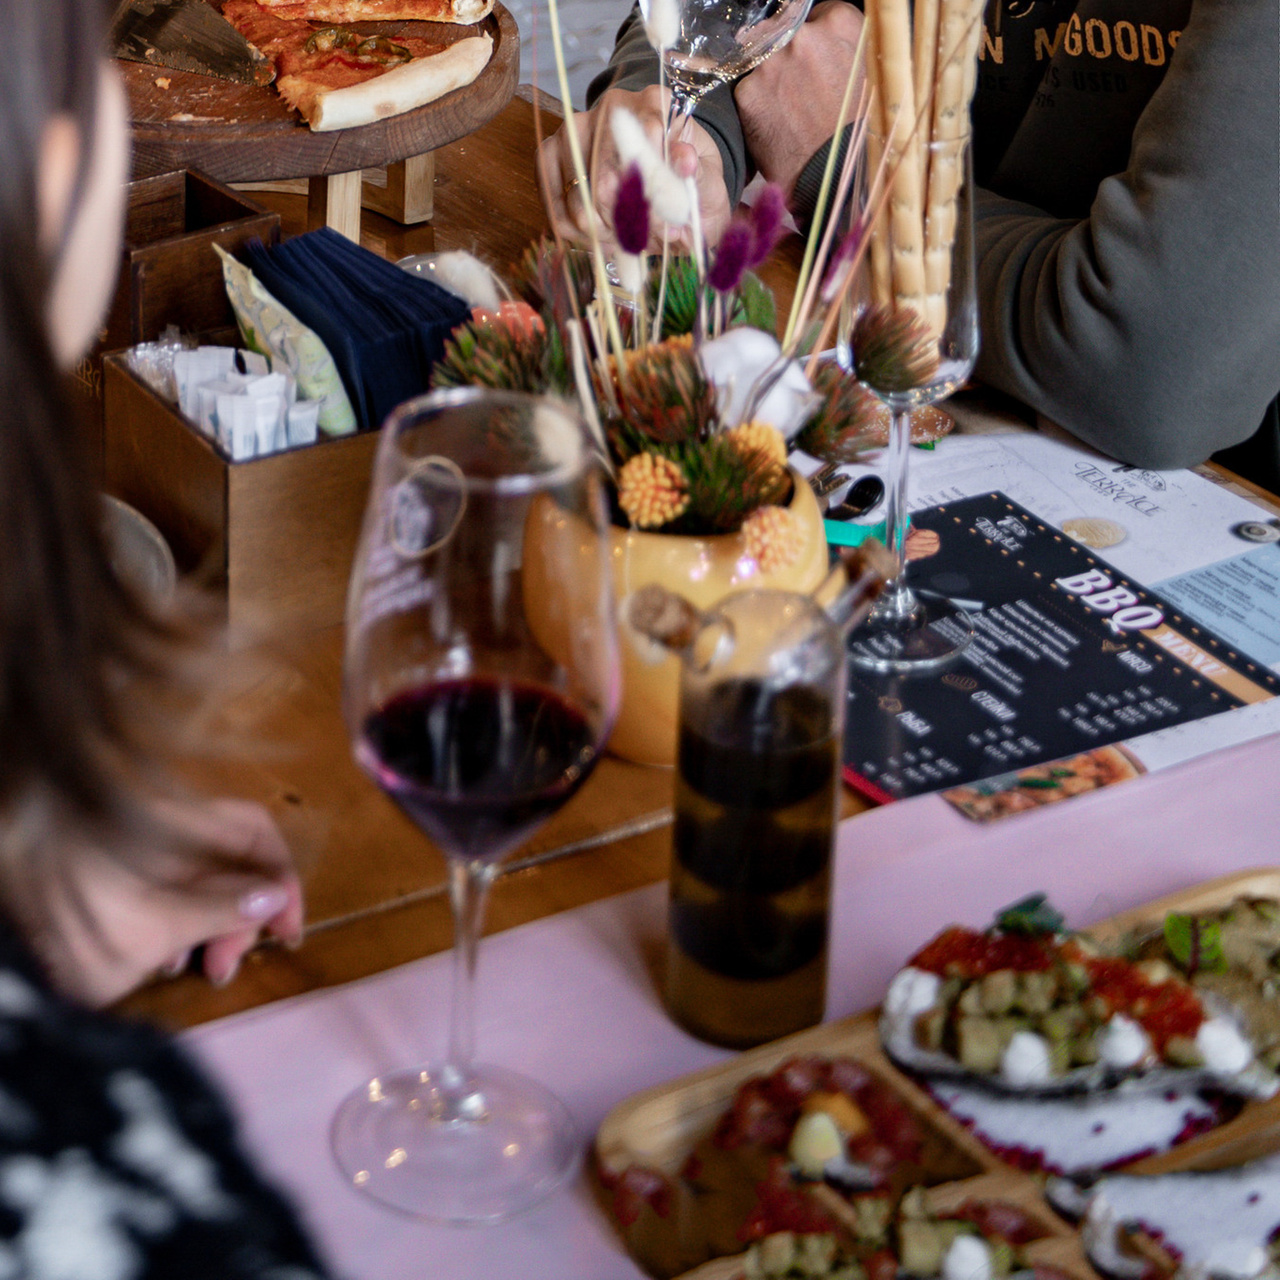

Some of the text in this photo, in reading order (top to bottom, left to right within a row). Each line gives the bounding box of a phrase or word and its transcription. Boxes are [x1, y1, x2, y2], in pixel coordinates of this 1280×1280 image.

[1074, 461, 1166, 517] TERRACE
[1055, 569, 1165, 634] BBQ
[1152, 630, 1228, 677] MENU
